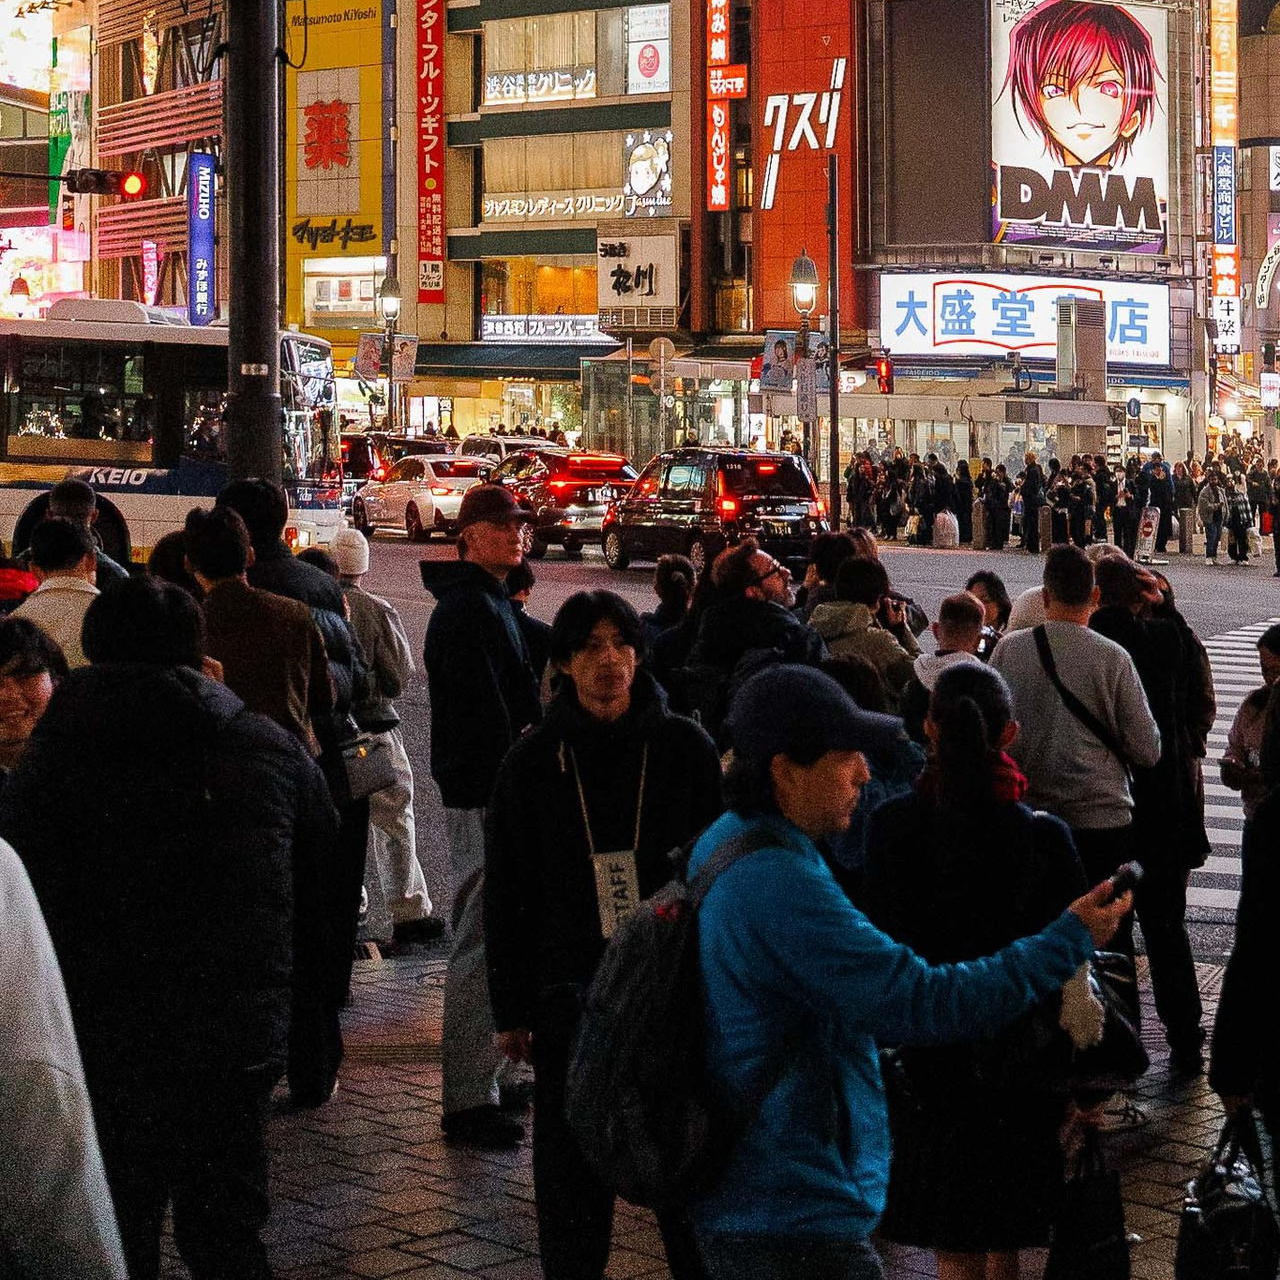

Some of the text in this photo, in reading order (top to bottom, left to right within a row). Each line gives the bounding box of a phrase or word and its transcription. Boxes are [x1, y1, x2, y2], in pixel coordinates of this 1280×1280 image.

[291, 12, 342, 27] Matsumoto
[304, 99, 351, 170] 薬
[761, 57, 847, 211] クスリ
[198, 166, 211, 220] MIZUHO
[1000, 166, 1161, 230] DMM
[1216, 151, 1233, 239] 大盛堂商事ビル
[895, 289, 1149, 345] 大盛堂店
[88, 467, 148, 486] KEIO
